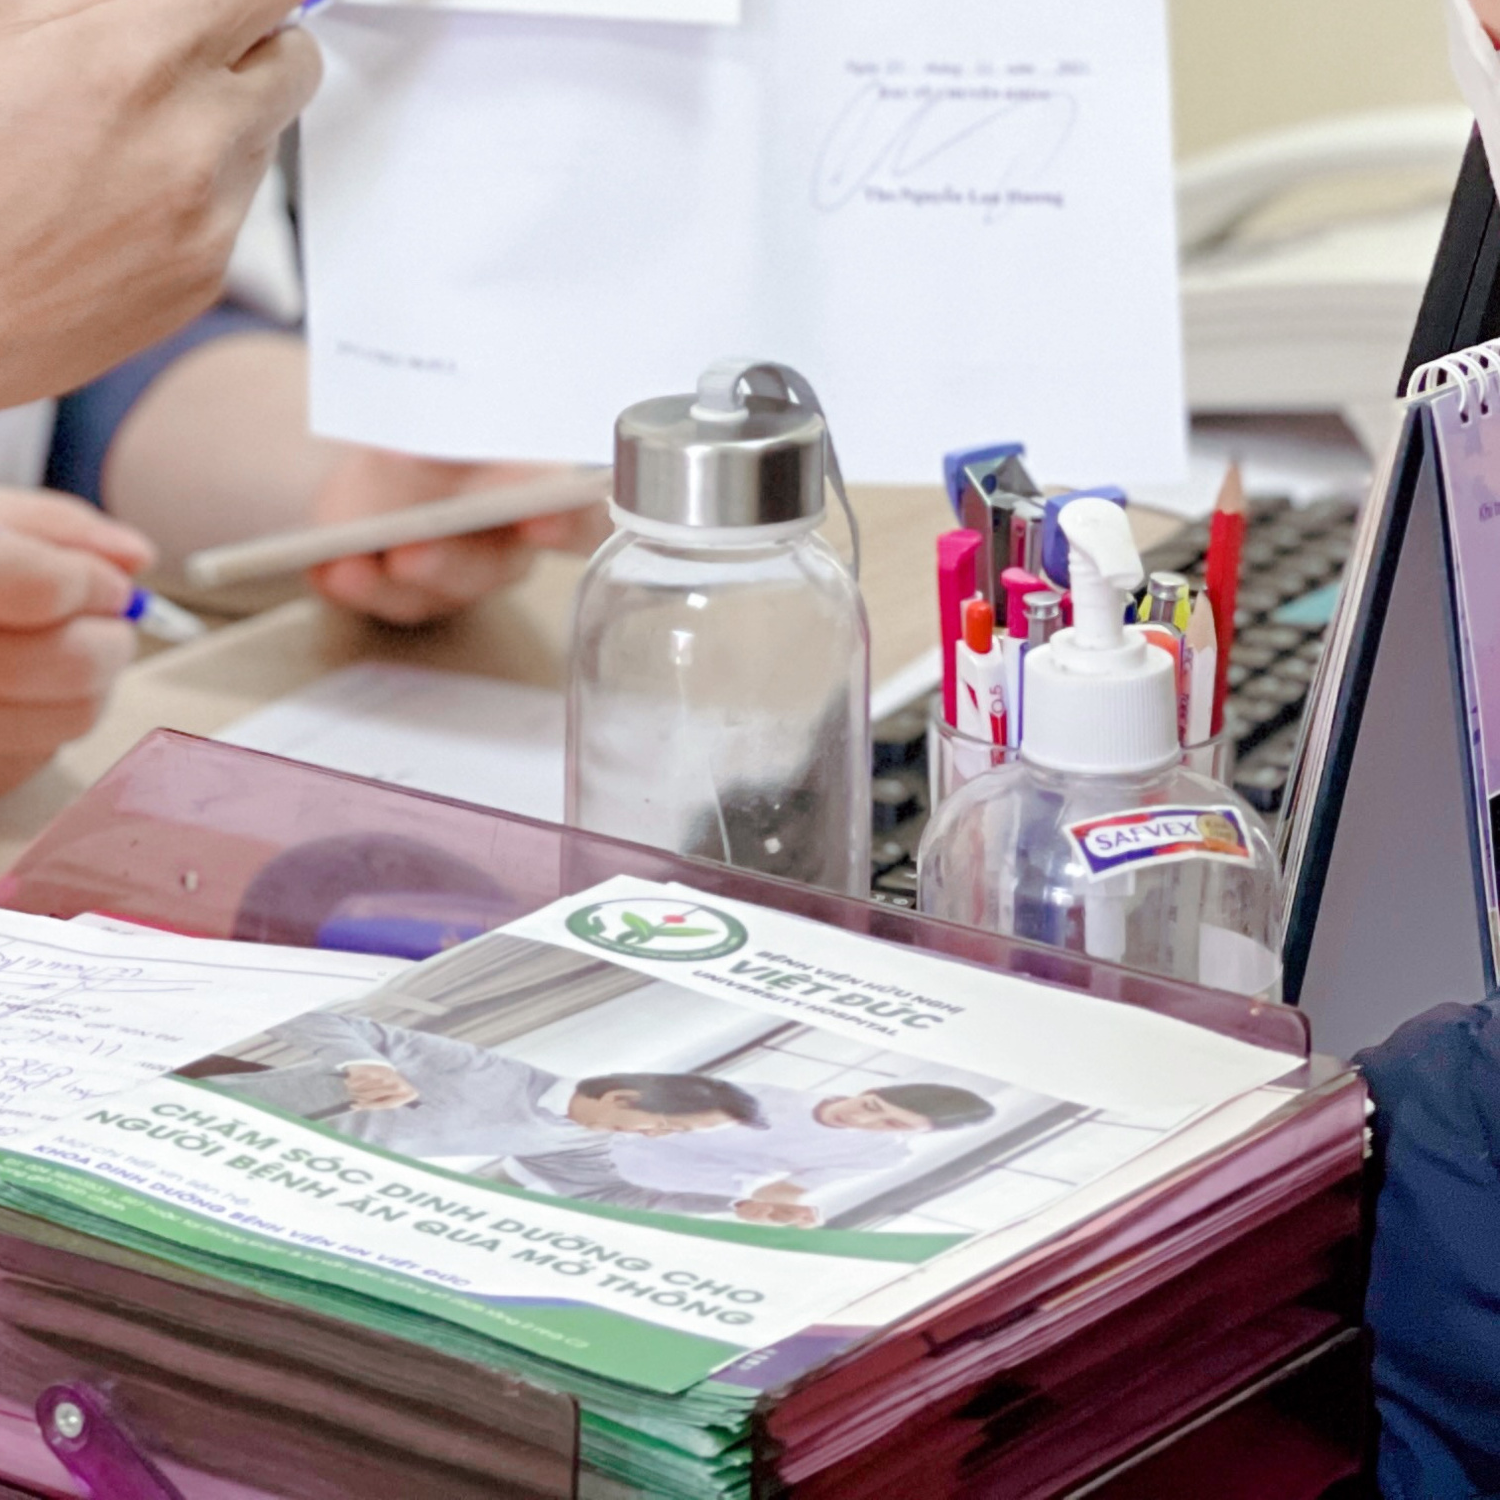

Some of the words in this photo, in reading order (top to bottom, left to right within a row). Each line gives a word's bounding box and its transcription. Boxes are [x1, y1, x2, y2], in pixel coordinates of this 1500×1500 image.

[1095, 821, 1198, 850] SAFVEX
[692, 968, 806, 1008] UNIVERSITY
[807, 1000, 900, 1038] HOSPITAL
[729, 958, 837, 997] VIỆT
[833, 983, 945, 1030] ĐỨC
[33, 1144, 91, 1165] KHOA
[95, 1162, 148, 1184] DINH
[84, 1109, 224, 1159] NGƯỜI
[225, 1153, 338, 1200] BỆNH
[337, 1193, 408, 1224] ĂN
[412, 1219, 504, 1253] QUA
[595, 1272, 756, 1326] THÔNG
[150, 1103, 282, 1151] CHĂM
[280, 1147, 374, 1185] SÓC
[377, 1182, 488, 1222] DINH
[487, 1217, 653, 1272] DƯỠNG
[660, 1270, 767, 1304] CHO
